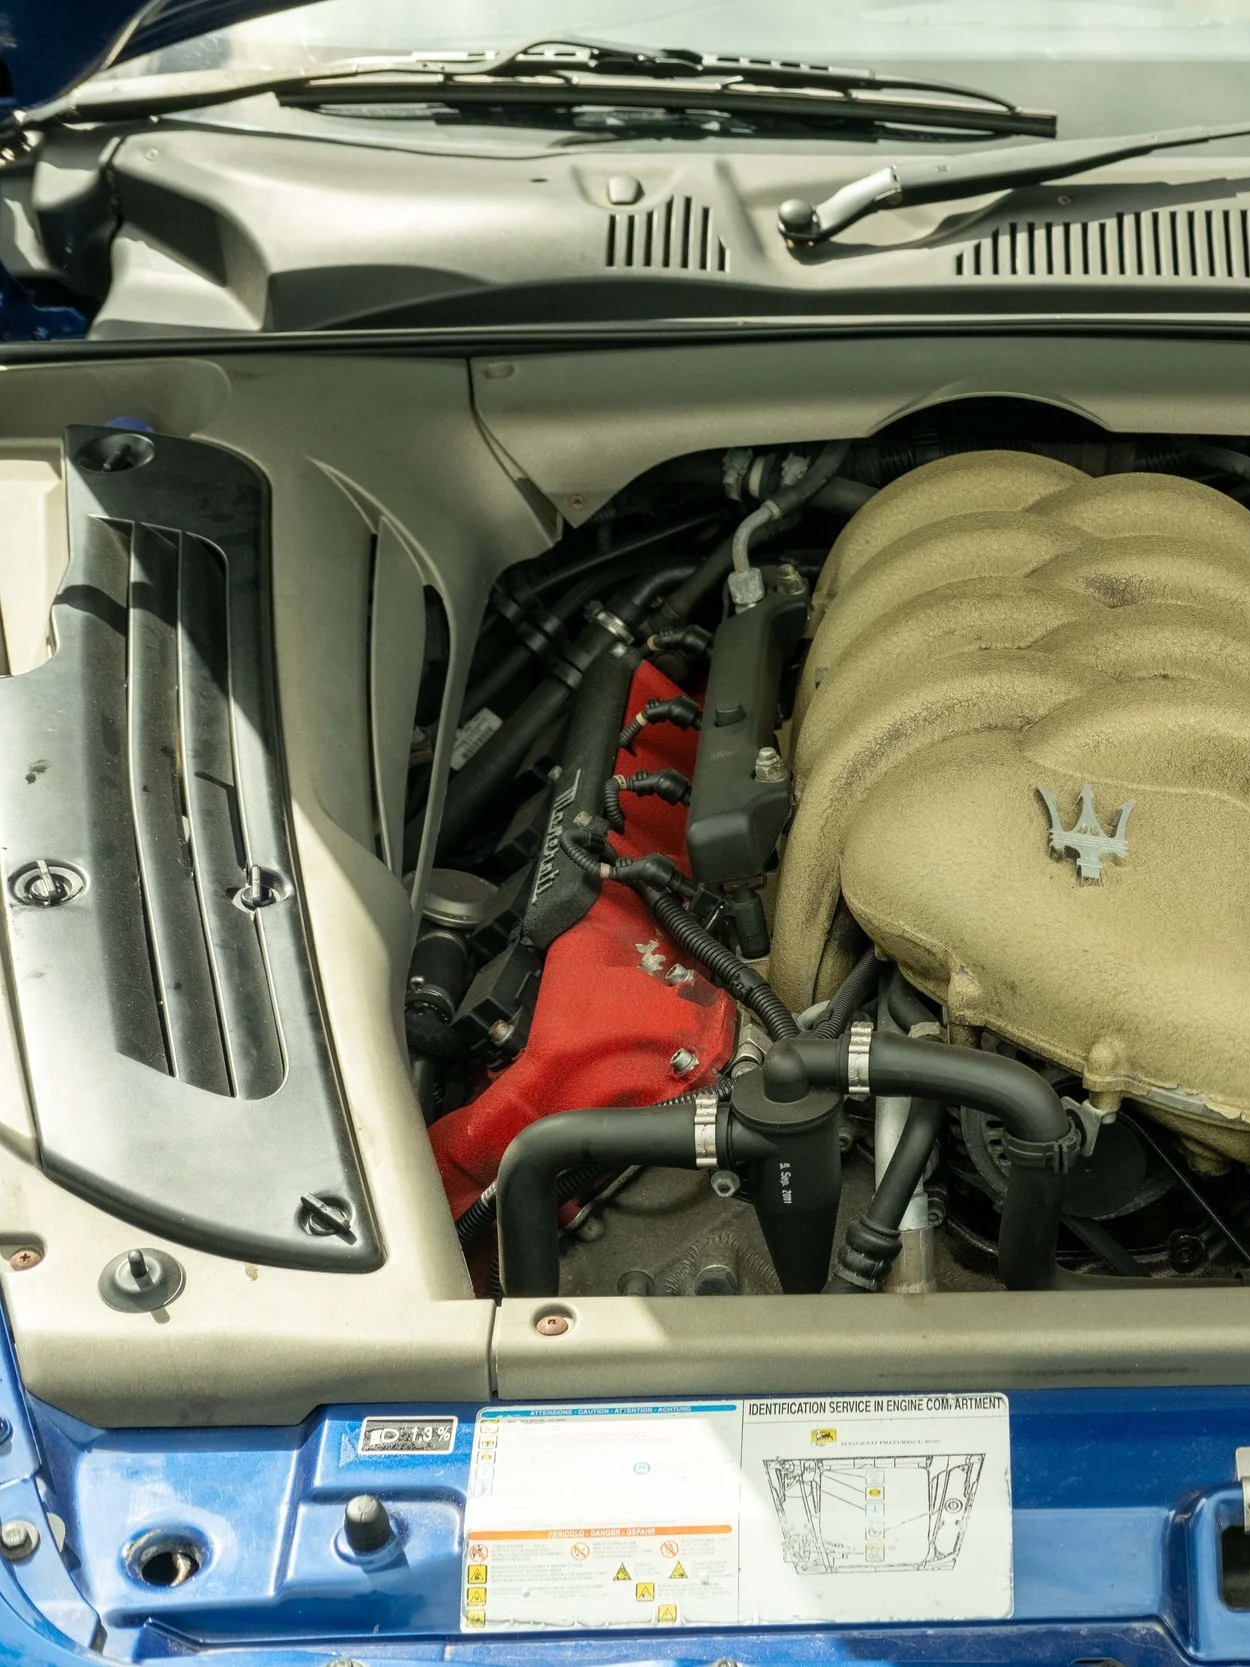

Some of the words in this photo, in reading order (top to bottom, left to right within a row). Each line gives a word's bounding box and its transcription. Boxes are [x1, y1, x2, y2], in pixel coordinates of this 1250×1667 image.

[748, 1401, 827, 1416] IDENTIFICATION
[829, 1400, 871, 1413] SERVICE
[874, 1400, 884, 1412] IN
[886, 1399, 924, 1412] ENGINE
[926, 1397, 1002, 1411] COMARTMENT
[530, 1409, 573, 1417] ATTENZIONE
[590, 1528, 621, 1537] DANGER
[626, 1527, 656, 1536] GEFAHR
